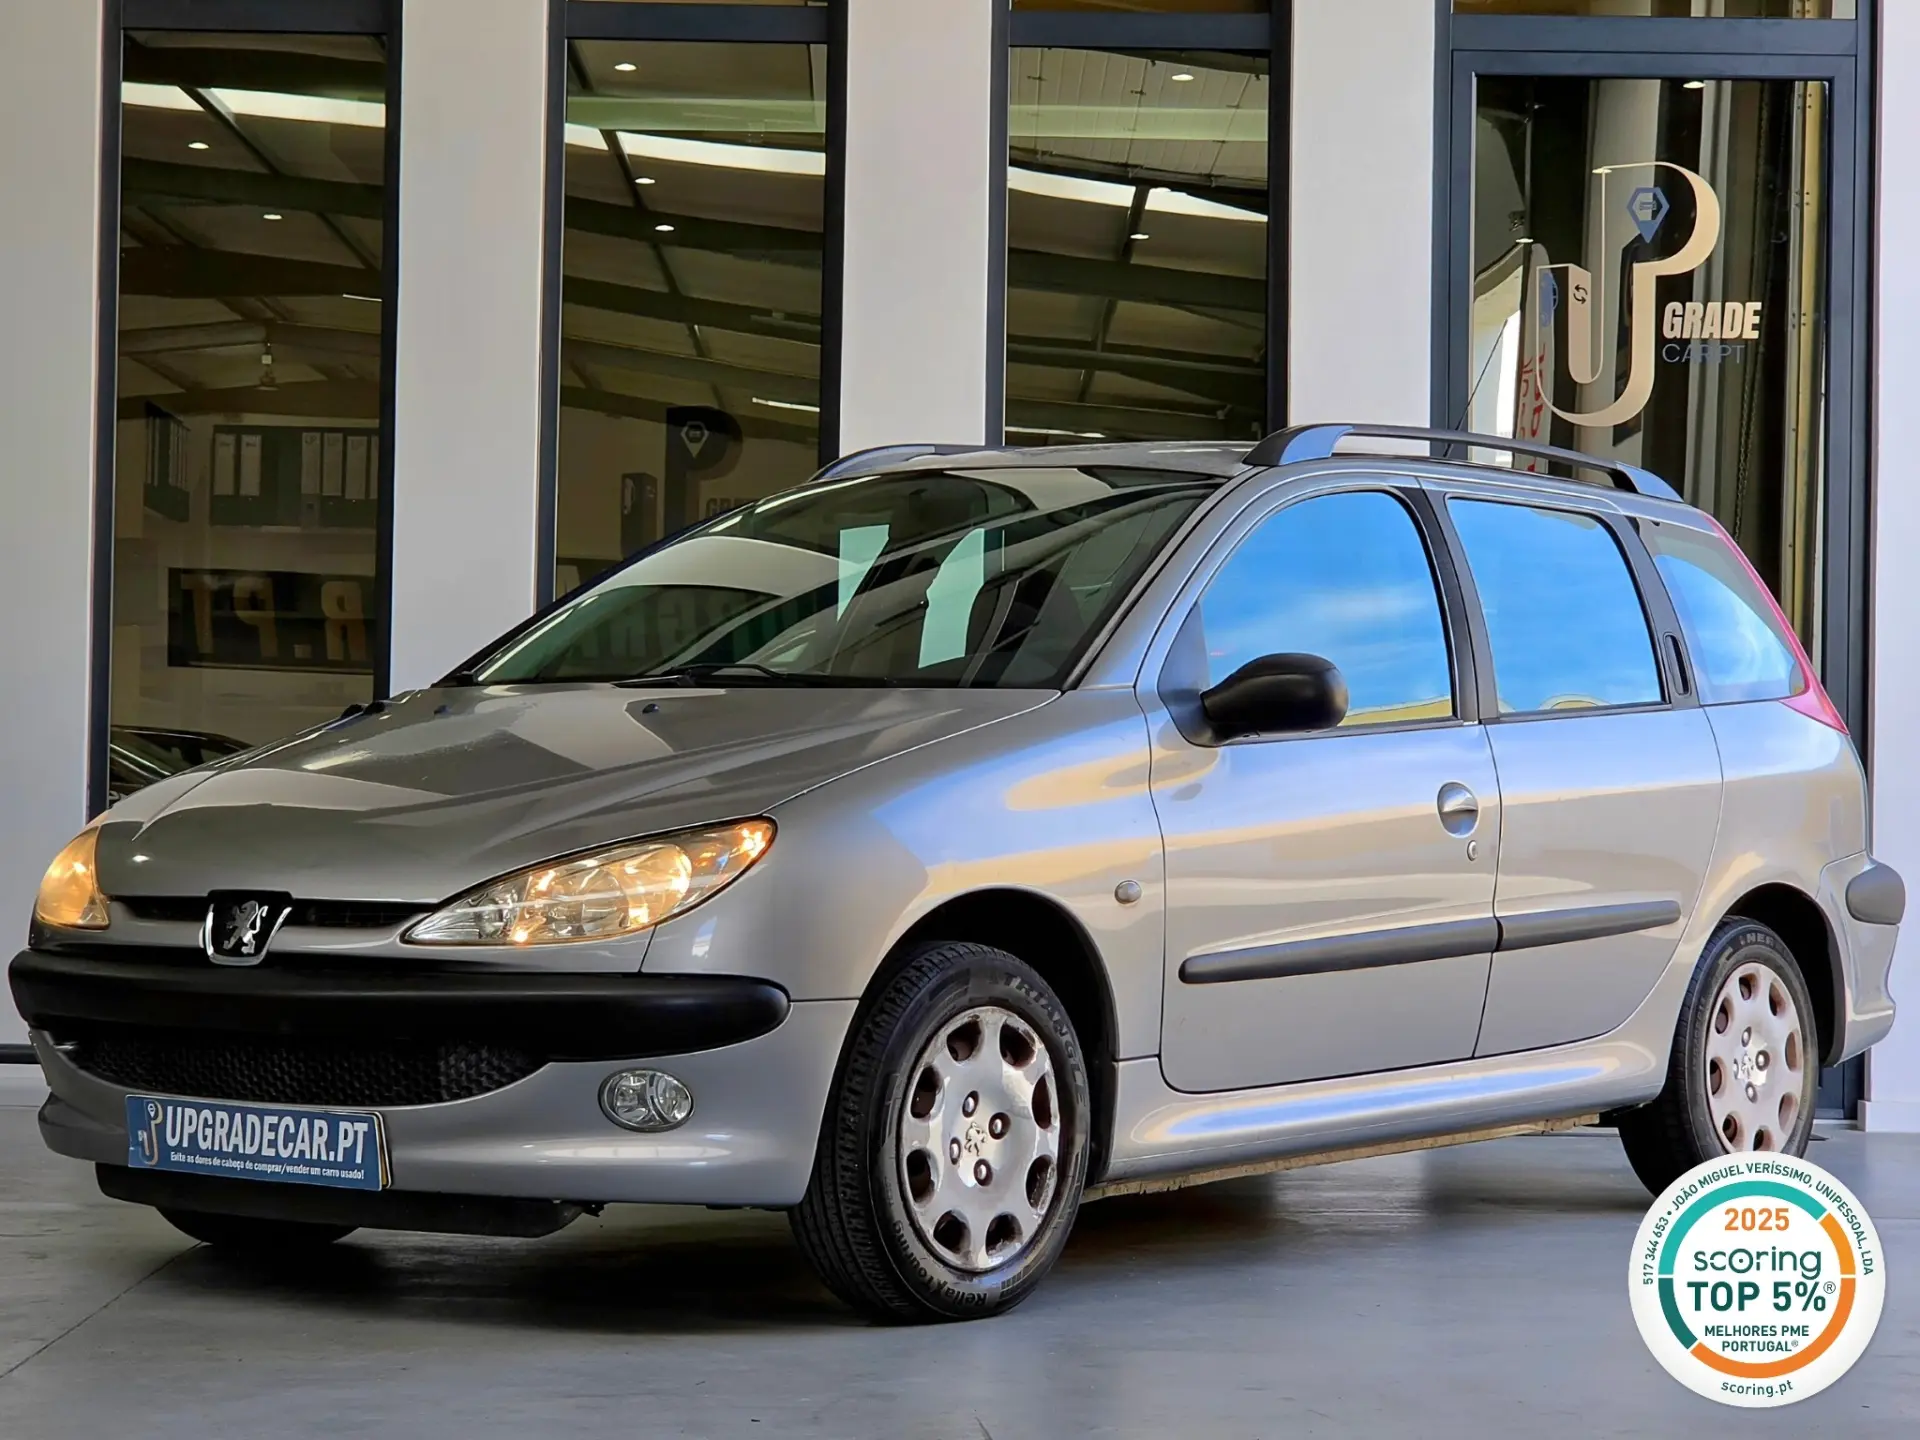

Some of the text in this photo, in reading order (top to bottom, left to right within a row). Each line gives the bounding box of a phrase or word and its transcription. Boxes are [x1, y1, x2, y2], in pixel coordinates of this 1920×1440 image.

[1662, 301, 1762, 339] GRADE
[165, 1106, 369, 1164] UPGRADECAR.PT
[170, 1151, 186, 1162] Evite
[186, 1155, 194, 1164] as
[194, 1154, 212, 1166] dores
[212, 1157, 221, 1166] de
[221, 1158, 244, 1171] cabeça
[245, 1160, 254, 1170] de
[310, 1168, 321, 1176] um
[322, 1168, 339, 1178] carro
[340, 1169, 365, 1180] usado!
